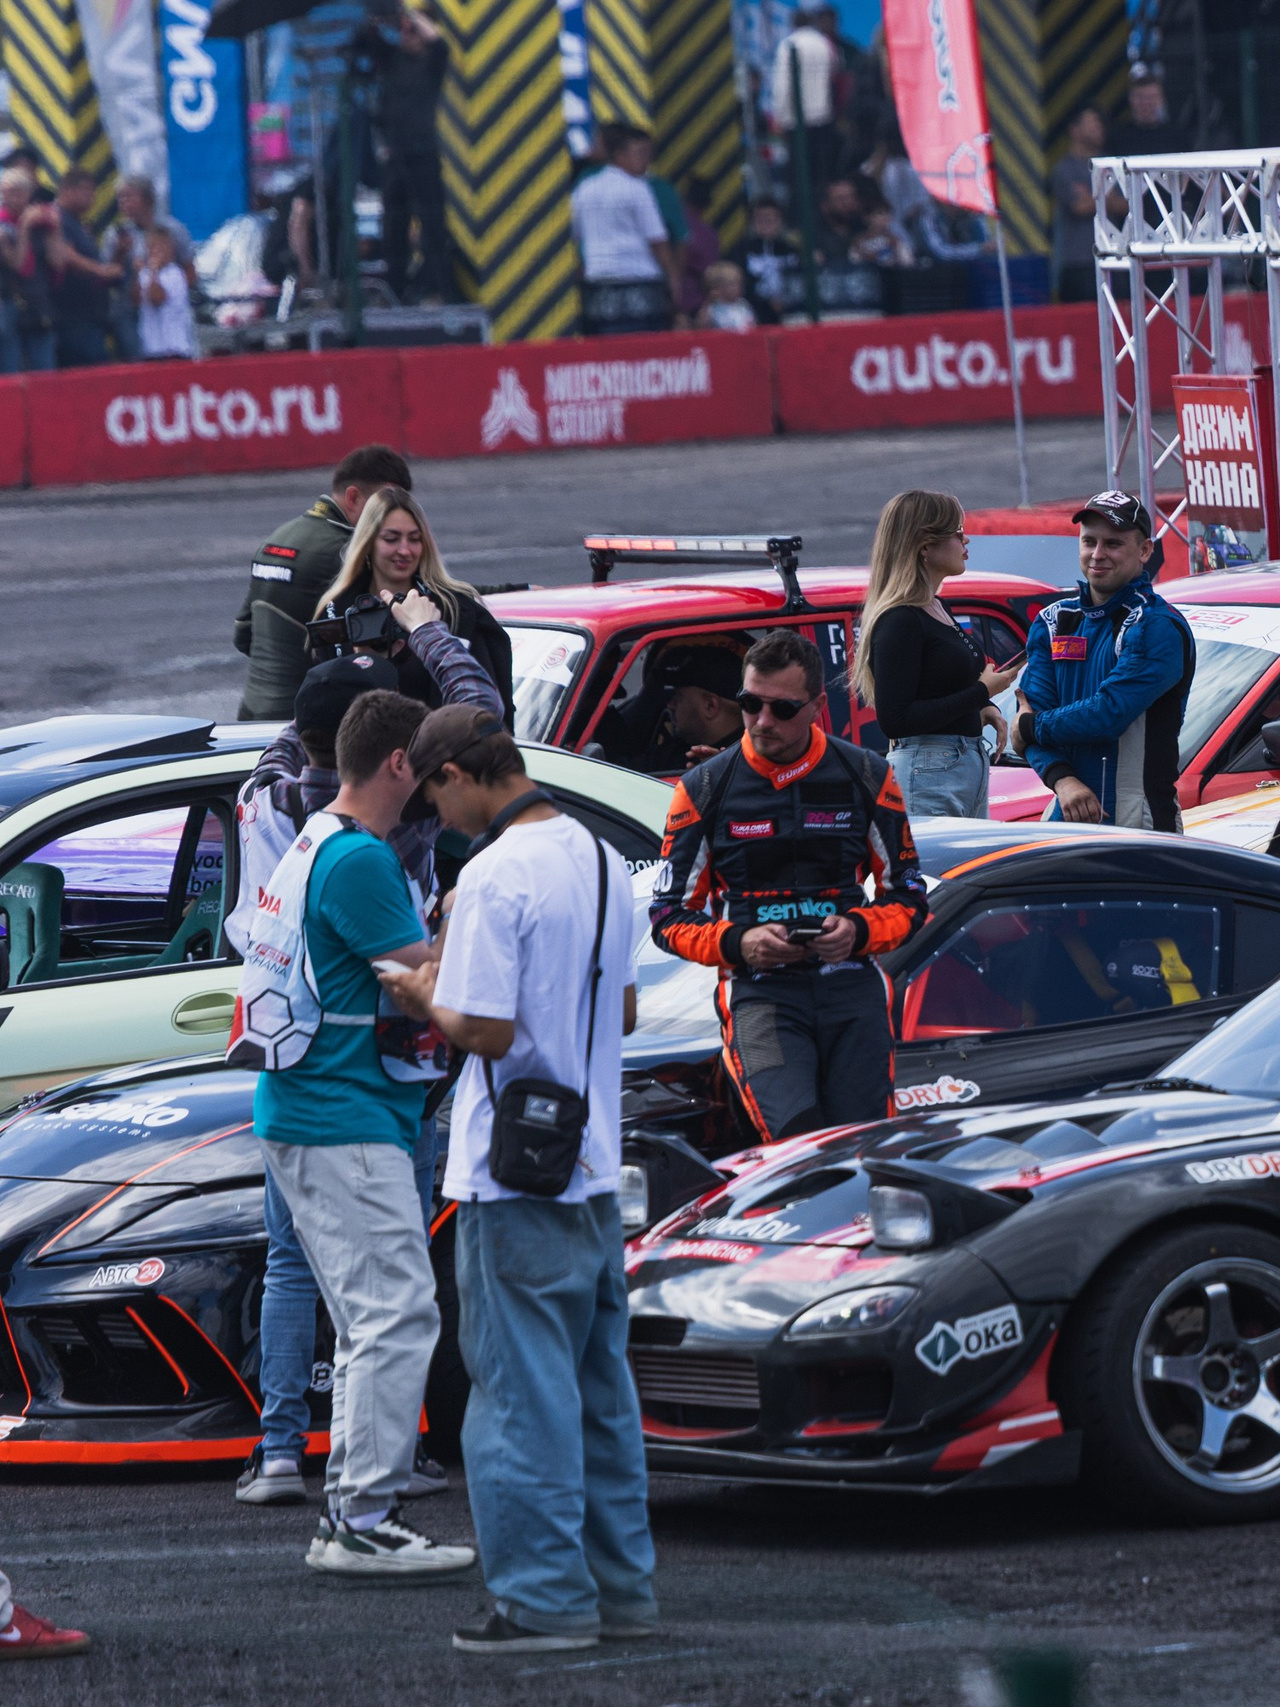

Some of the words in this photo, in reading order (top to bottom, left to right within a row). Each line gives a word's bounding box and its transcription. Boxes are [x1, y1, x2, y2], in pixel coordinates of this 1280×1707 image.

[852, 334, 1074, 396] auto.ru
[105, 383, 342, 446] auto.ru
[1182, 403, 1254, 456] ДЖИМ
[1186, 459, 1260, 509] ХАНА
[751, 821, 772, 832] DRIVE
[805, 811, 836, 823] RDS
[835, 811, 852, 821] GP
[78, 1123, 152, 1139] systems
[697, 1243, 754, 1261] RACING
